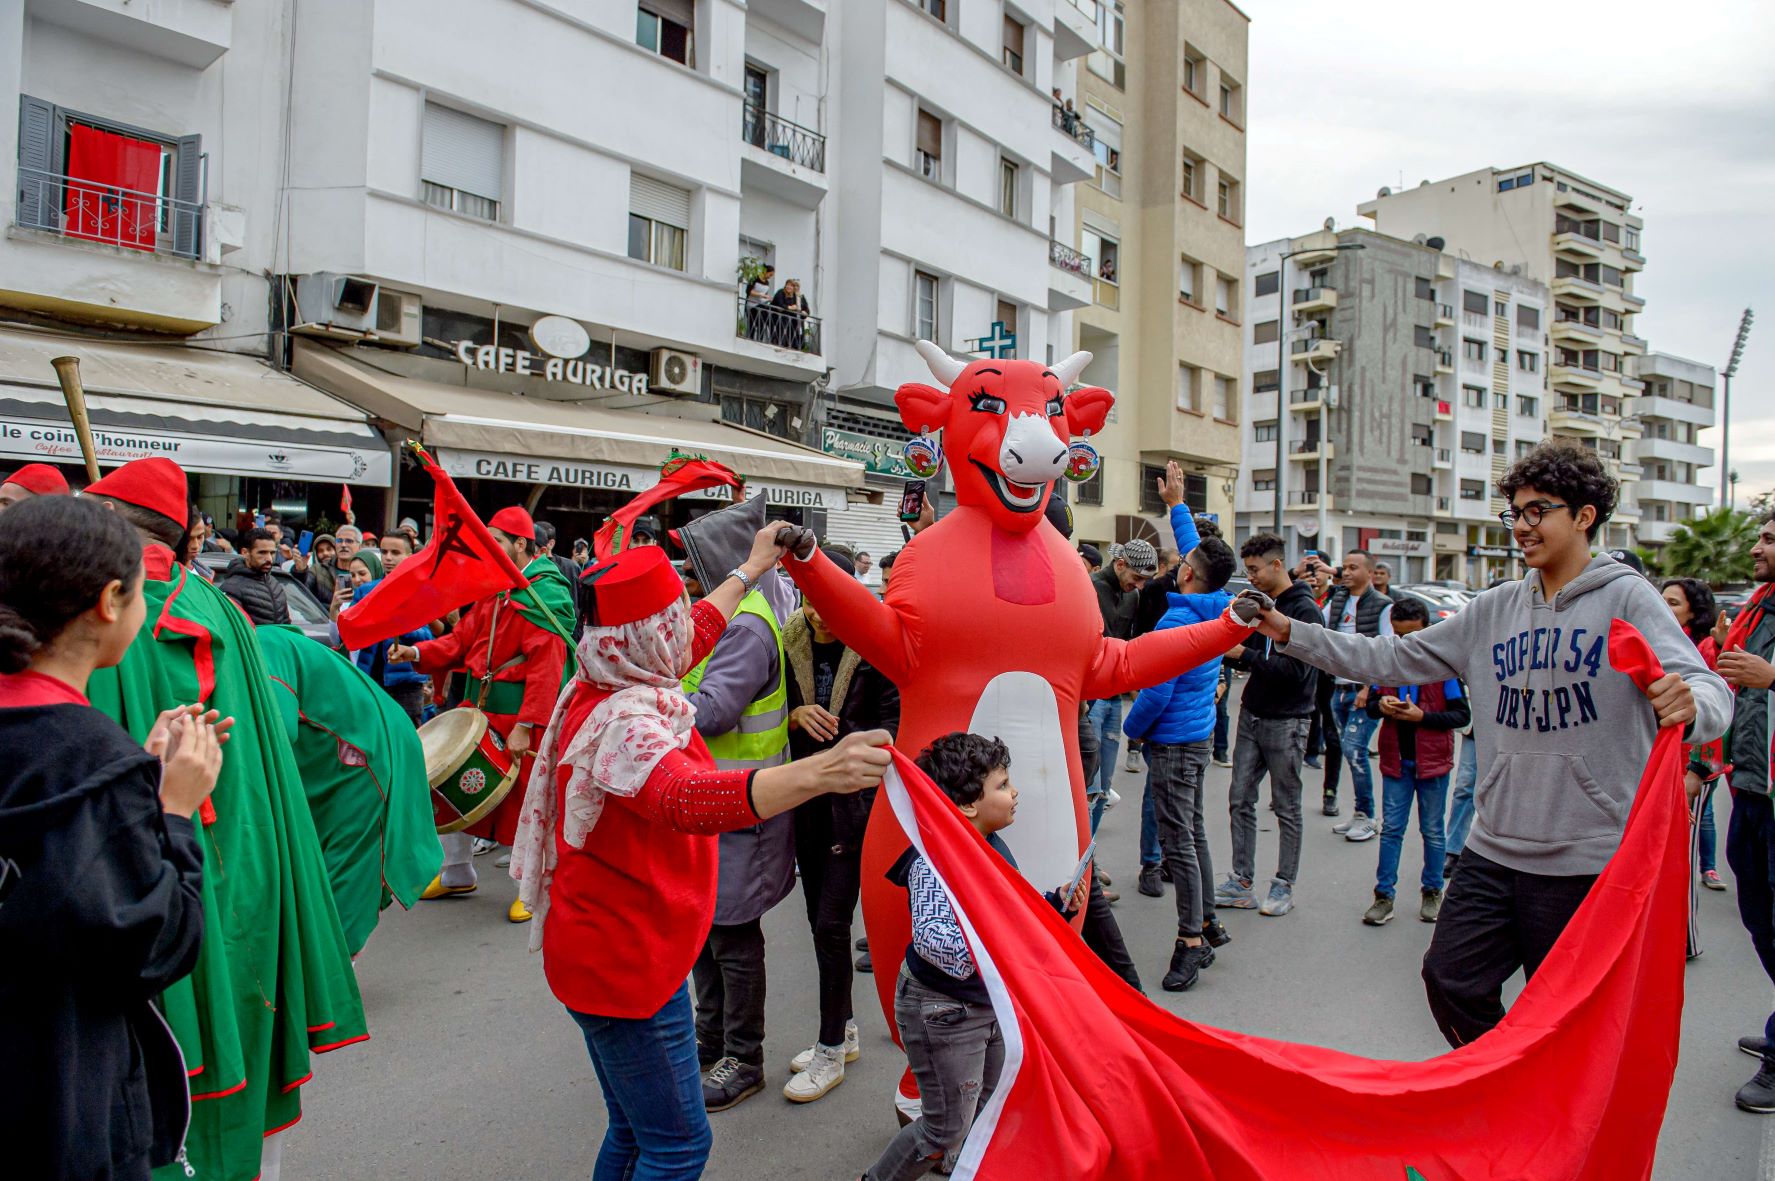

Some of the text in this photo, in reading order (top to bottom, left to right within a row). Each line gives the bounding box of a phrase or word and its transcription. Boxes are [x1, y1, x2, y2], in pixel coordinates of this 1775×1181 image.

[458, 340, 649, 396] CAFE AURIGA
[2, 425, 181, 452] le coin ’honneur
[35, 443, 73, 456] Coffee
[825, 431, 871, 454] Pharmacie
[476, 459, 631, 489] CAFE AURIGA
[703, 485, 753, 500] CAE
[1564, 629, 1604, 677] 54
